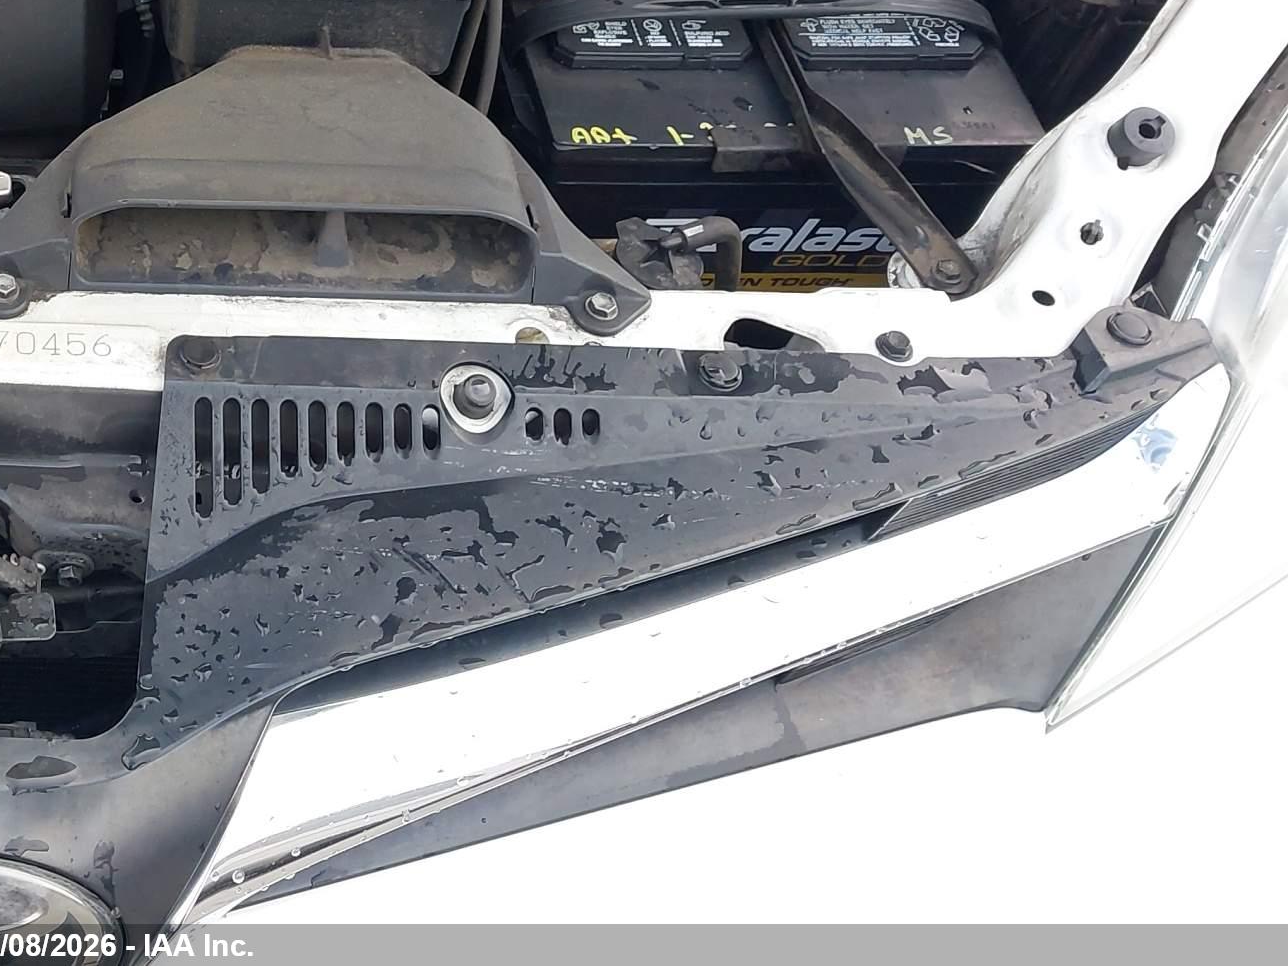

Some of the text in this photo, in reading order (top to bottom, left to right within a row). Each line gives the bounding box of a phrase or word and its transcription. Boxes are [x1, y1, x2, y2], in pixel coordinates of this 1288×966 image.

[645, 218, 896, 252] ralas
[772, 254, 890, 267] GOLD
[771, 277, 851, 288] TOUGH
